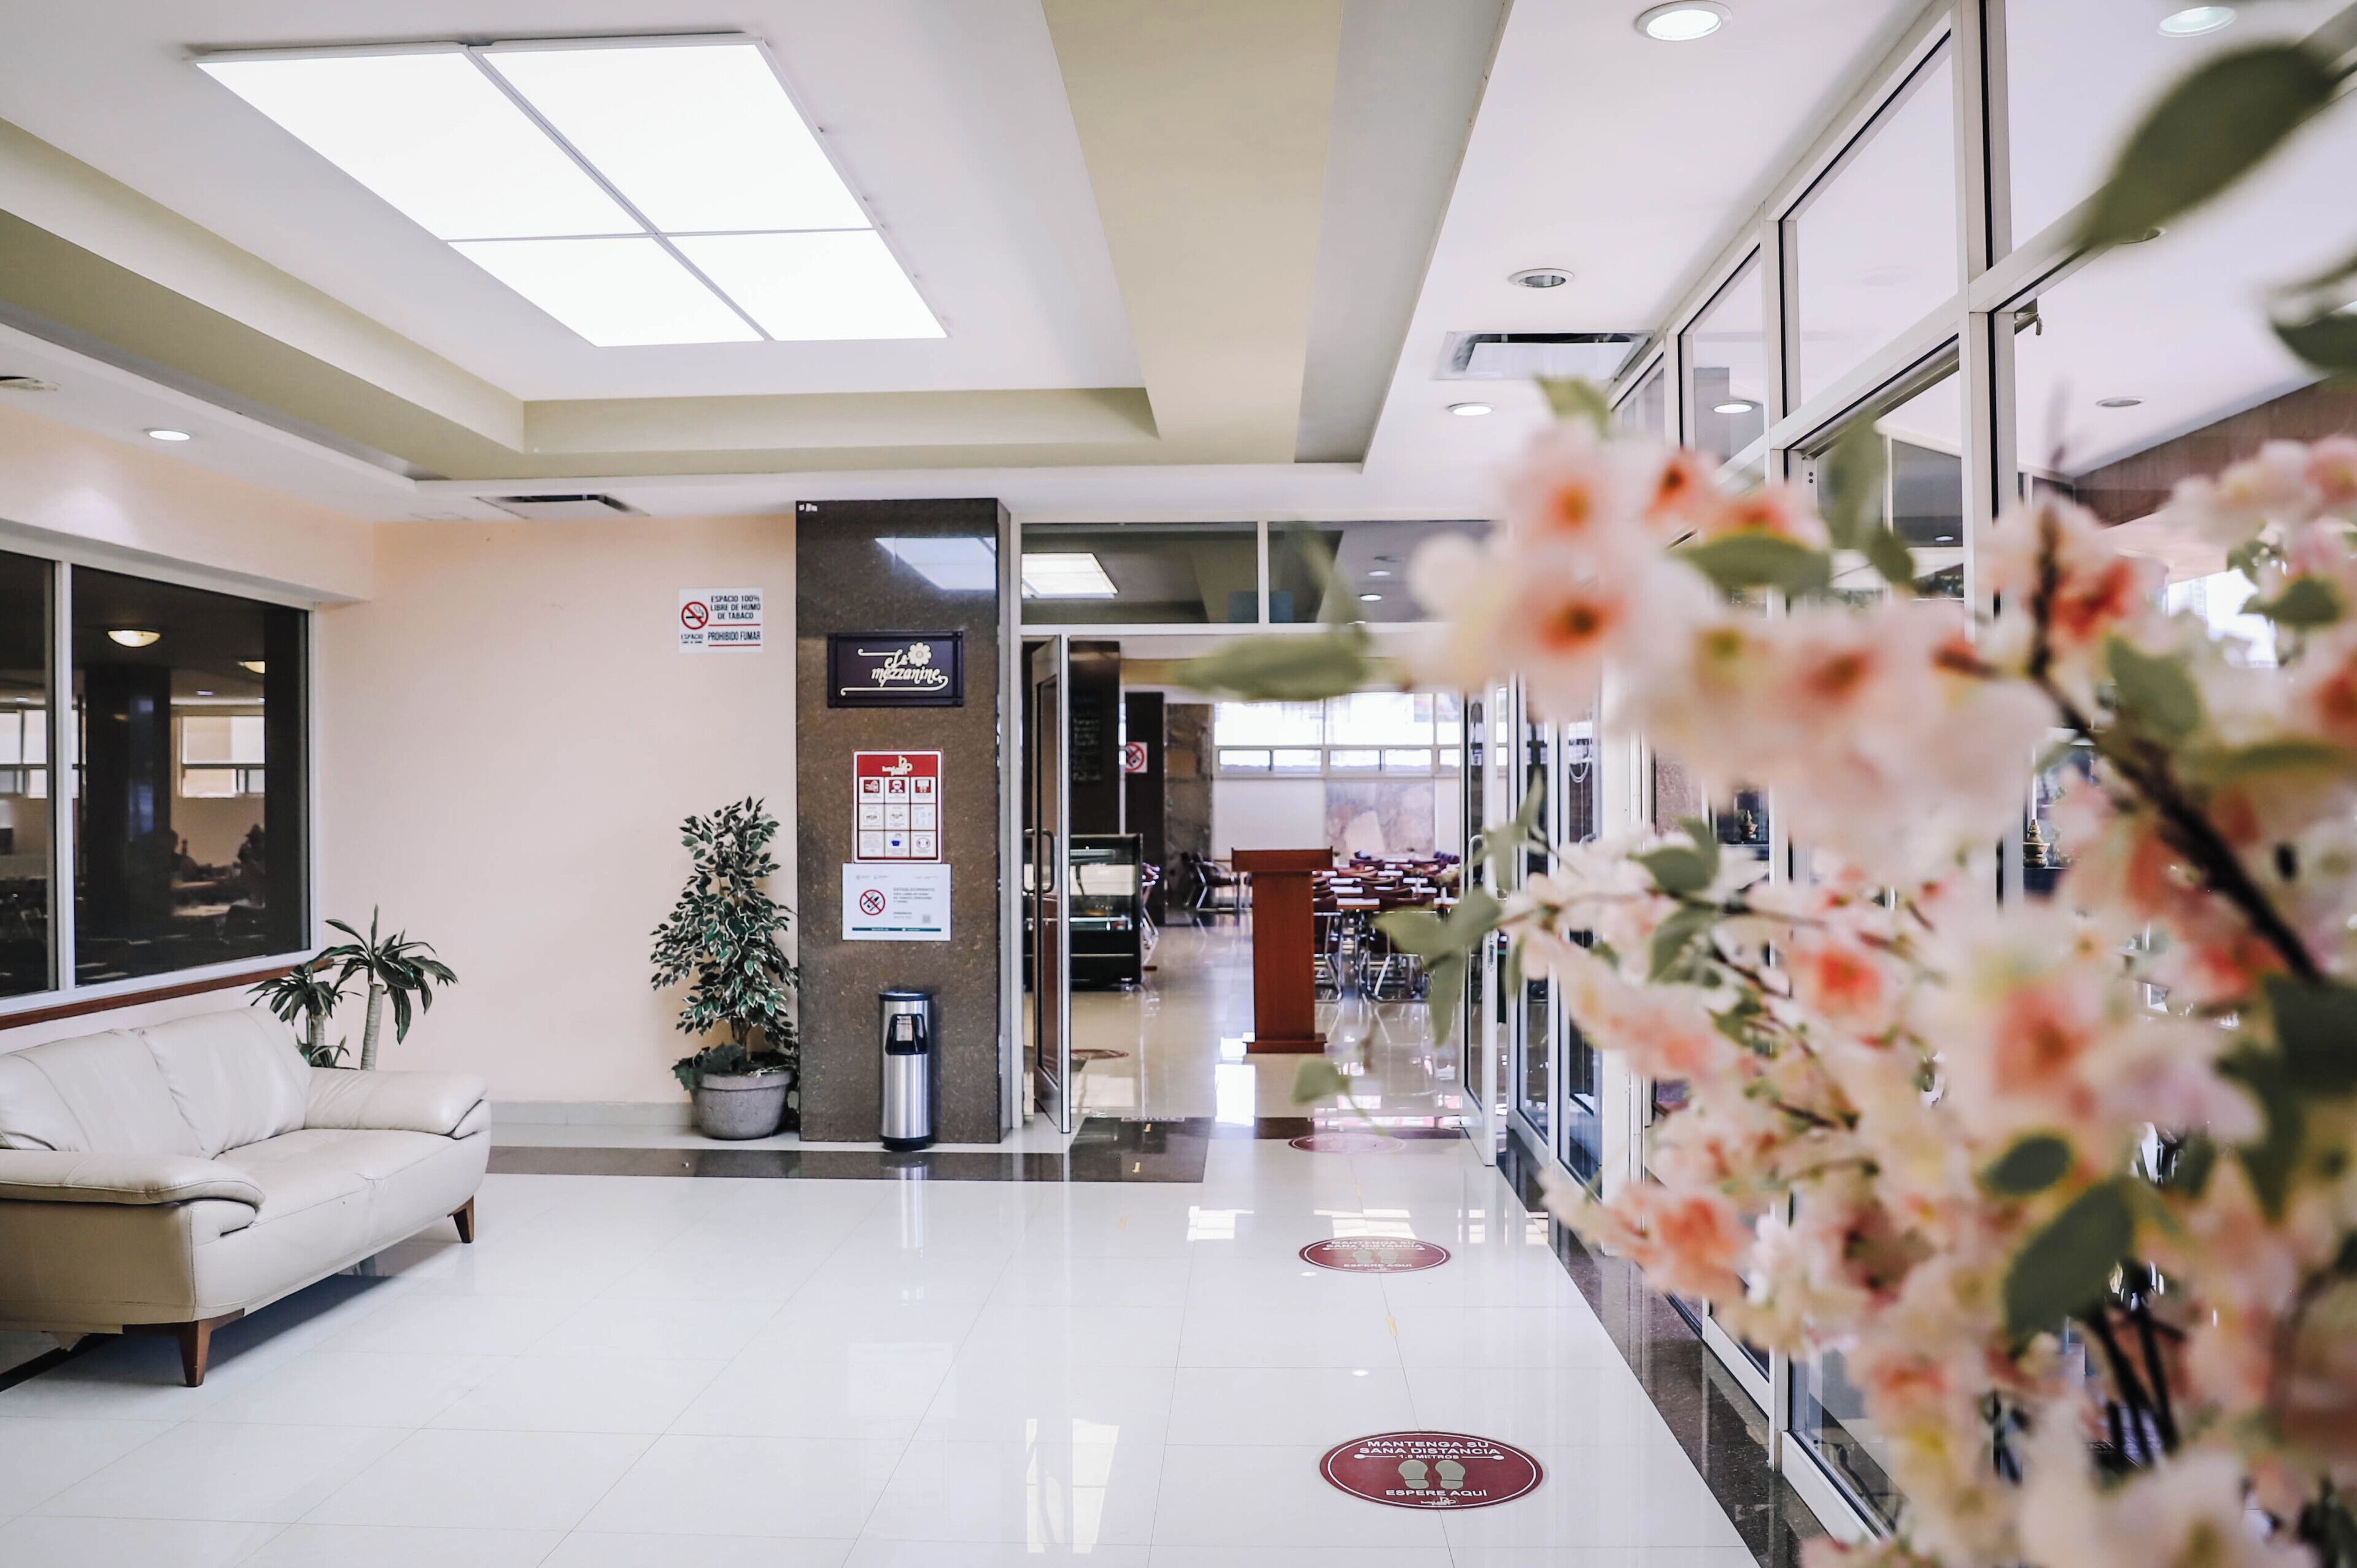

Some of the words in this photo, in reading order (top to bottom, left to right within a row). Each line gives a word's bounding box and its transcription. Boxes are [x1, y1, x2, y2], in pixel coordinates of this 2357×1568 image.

[708, 631, 738, 640] PROHIBIDO
[740, 631, 761, 640] FUMAR
[871, 666, 943, 687] mezzanine
